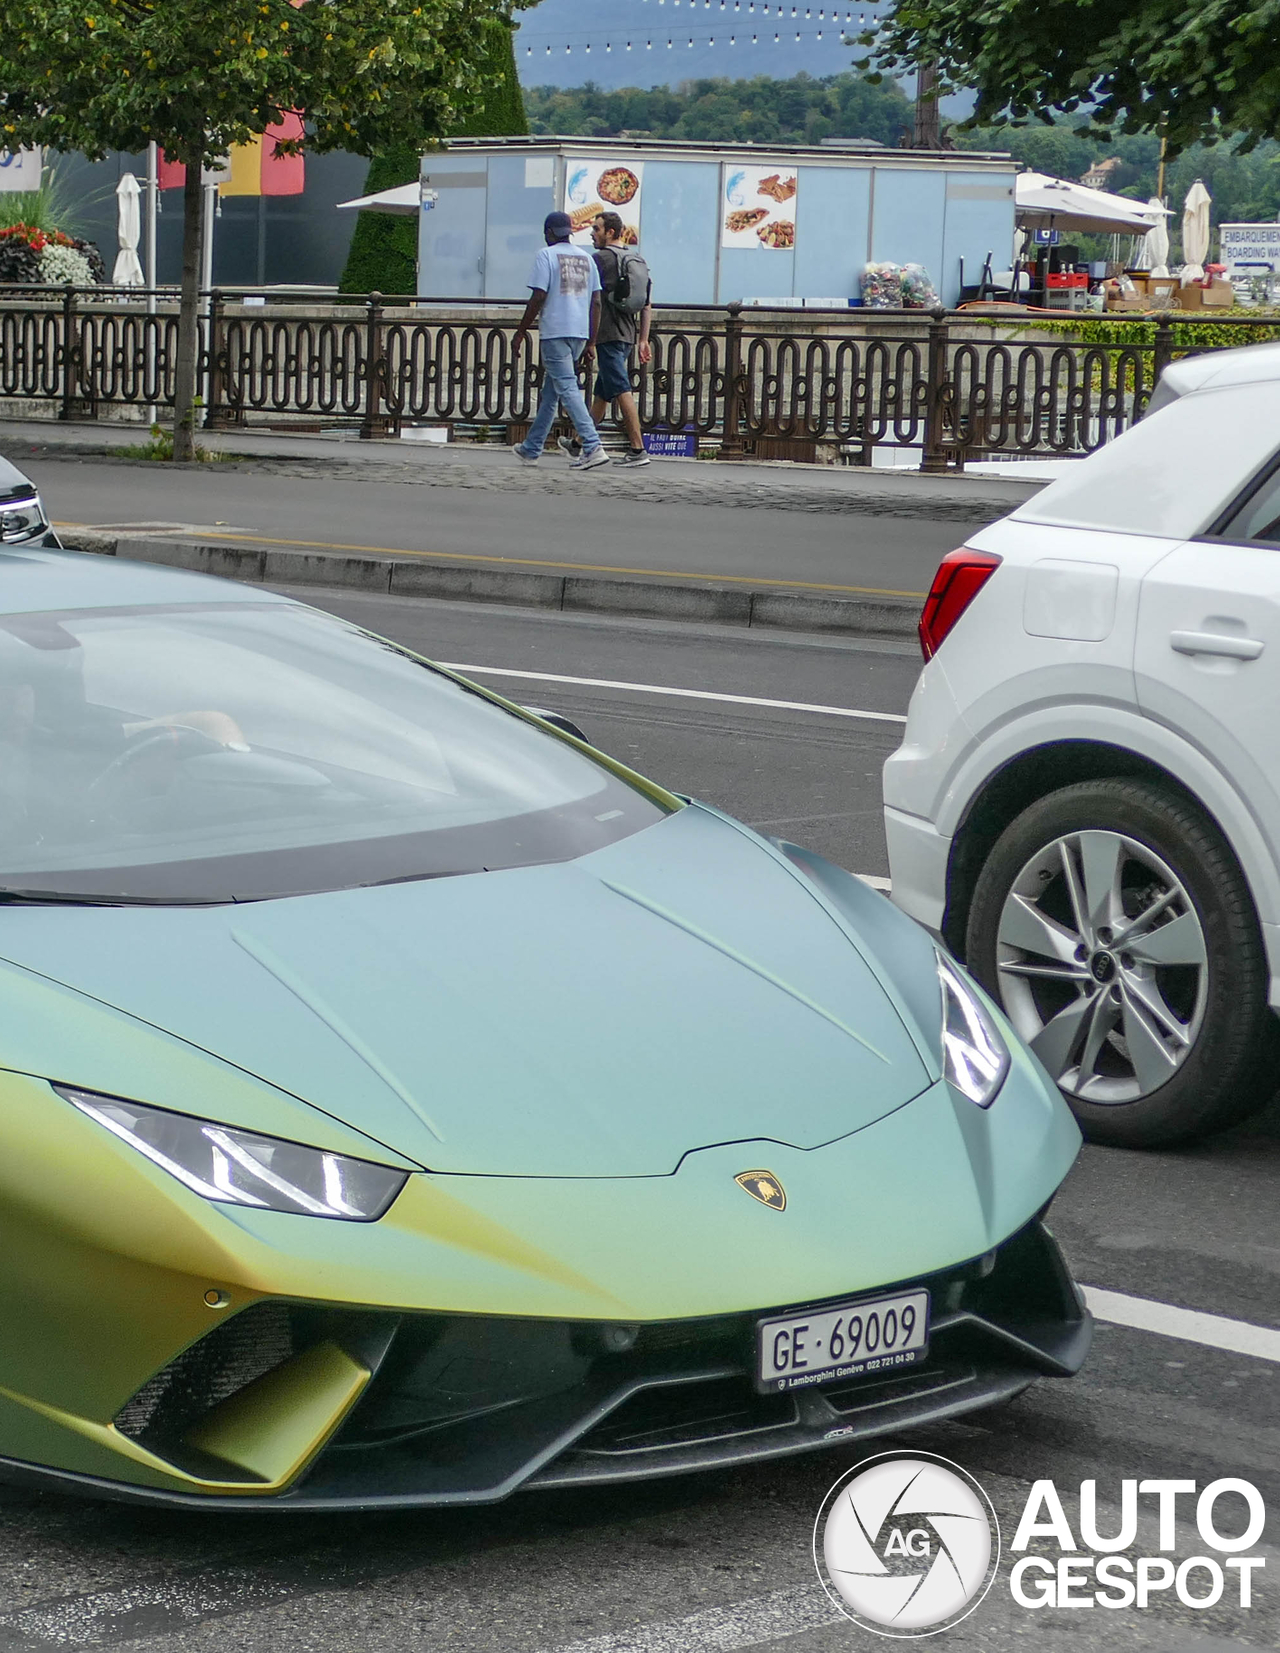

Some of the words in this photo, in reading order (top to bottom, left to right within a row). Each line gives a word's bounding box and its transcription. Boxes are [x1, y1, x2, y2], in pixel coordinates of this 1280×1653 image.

[1227, 247, 1266, 258] BOARDING
[648, 442, 664, 451] AUSSI
[664, 442, 677, 450] VITE
[677, 442, 687, 450] QUE
[788, 1368, 835, 1387] Lamborghini
[836, 1364, 864, 1377] Genève
[867, 1361, 881, 1370] 022
[881, 1357, 894, 1368] 721
[895, 1355, 905, 1364] 04
[905, 1352, 915, 1362] 30
